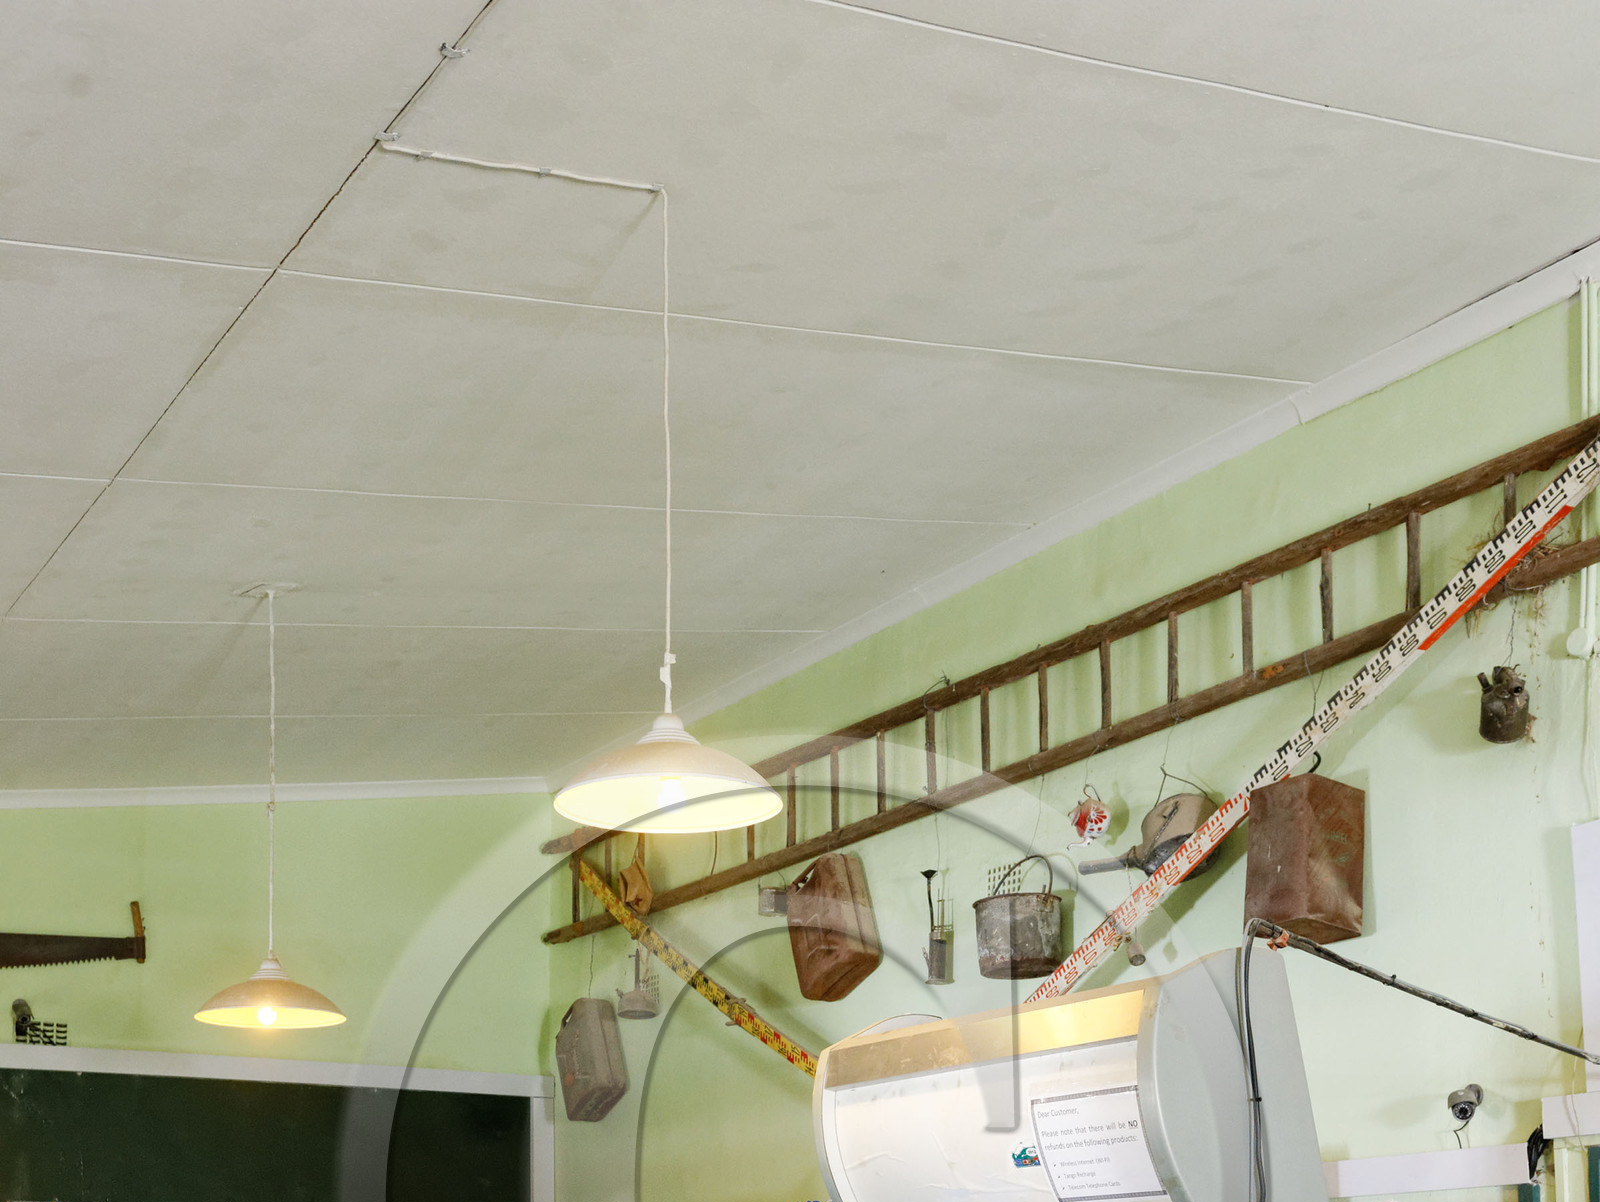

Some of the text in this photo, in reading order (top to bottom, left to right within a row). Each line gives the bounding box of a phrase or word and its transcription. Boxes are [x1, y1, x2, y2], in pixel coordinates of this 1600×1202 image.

[1050, 1108, 1079, 1117] Customer,
[1041, 1130, 1058, 1138] Please
[1060, 1128, 1073, 1136] note
[1075, 1126, 1087, 1134] that
[1089, 1124, 1104, 1132] there
[1106, 1122, 1116, 1130] will
[1128, 1120, 1138, 1128] NO
[1044, 1142, 1066, 1151] refunds
[1074, 1140, 1084, 1148] the
[1084, 1137, 1110, 1146] following
[1111, 1135, 1138, 1144] products:
